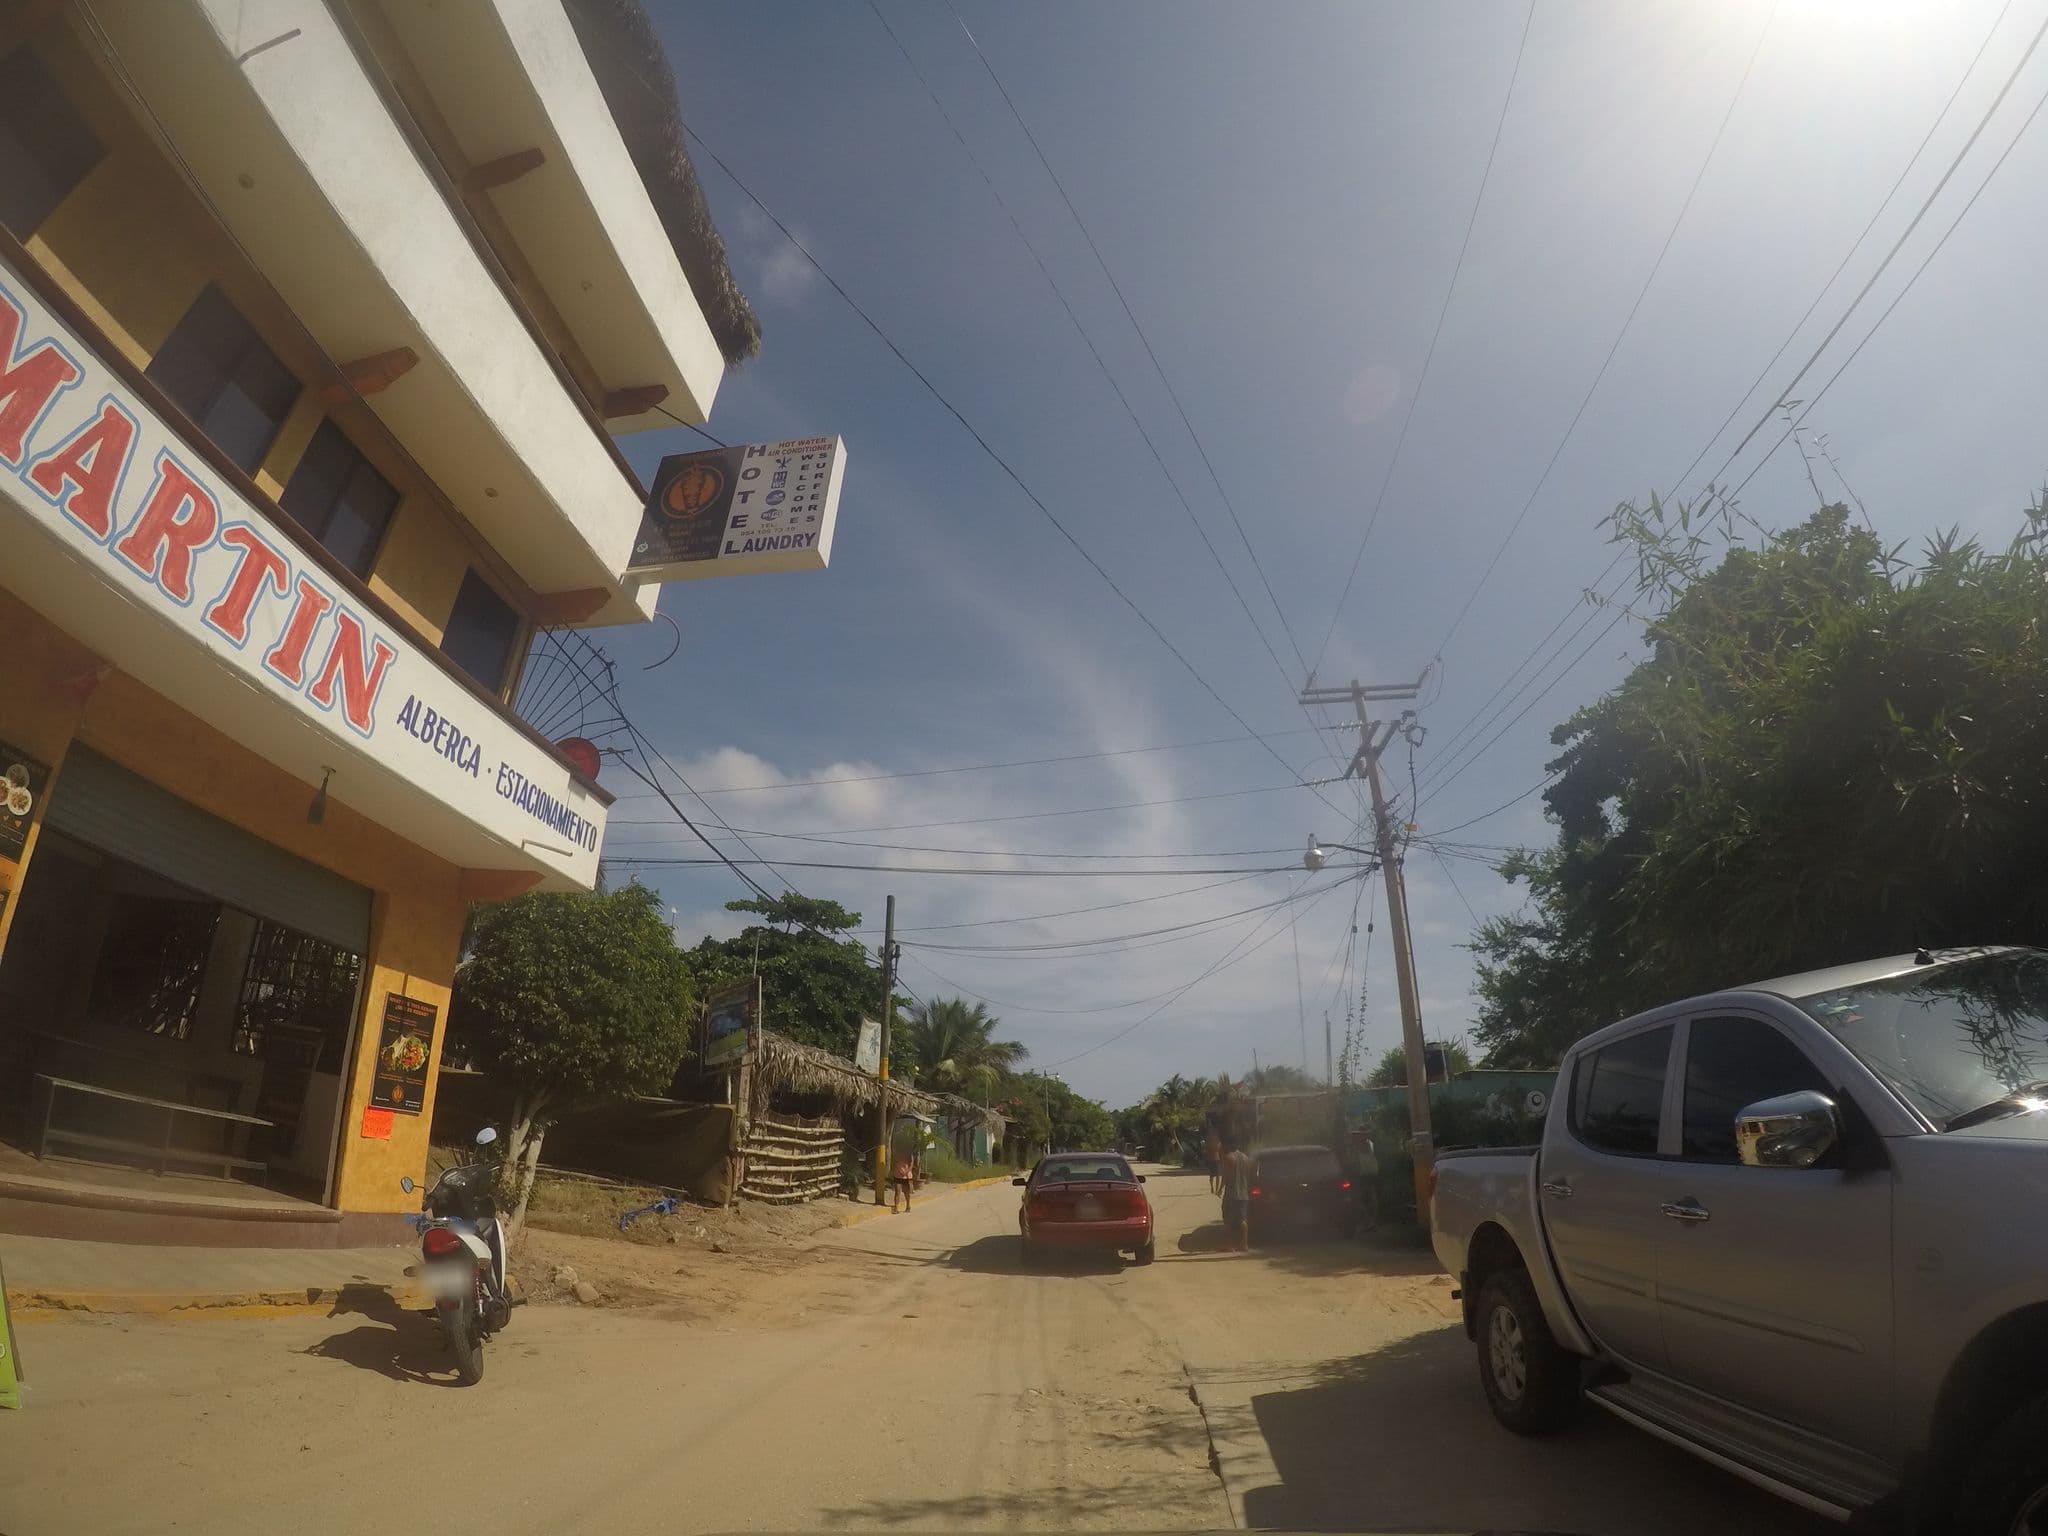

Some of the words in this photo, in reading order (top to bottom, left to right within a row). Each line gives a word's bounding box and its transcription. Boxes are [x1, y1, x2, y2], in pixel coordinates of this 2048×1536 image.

[778, 440, 797, 449] HOT
[797, 437, 827, 446] WATER
[0, 282, 399, 740] MARTIN
[806, 452, 828, 523] SURFERS
[724, 532, 817, 555] LAUNDRY
[396, 694, 481, 778] ALBERCA
[495, 761, 597, 852] ESTACIONAMIENTO
